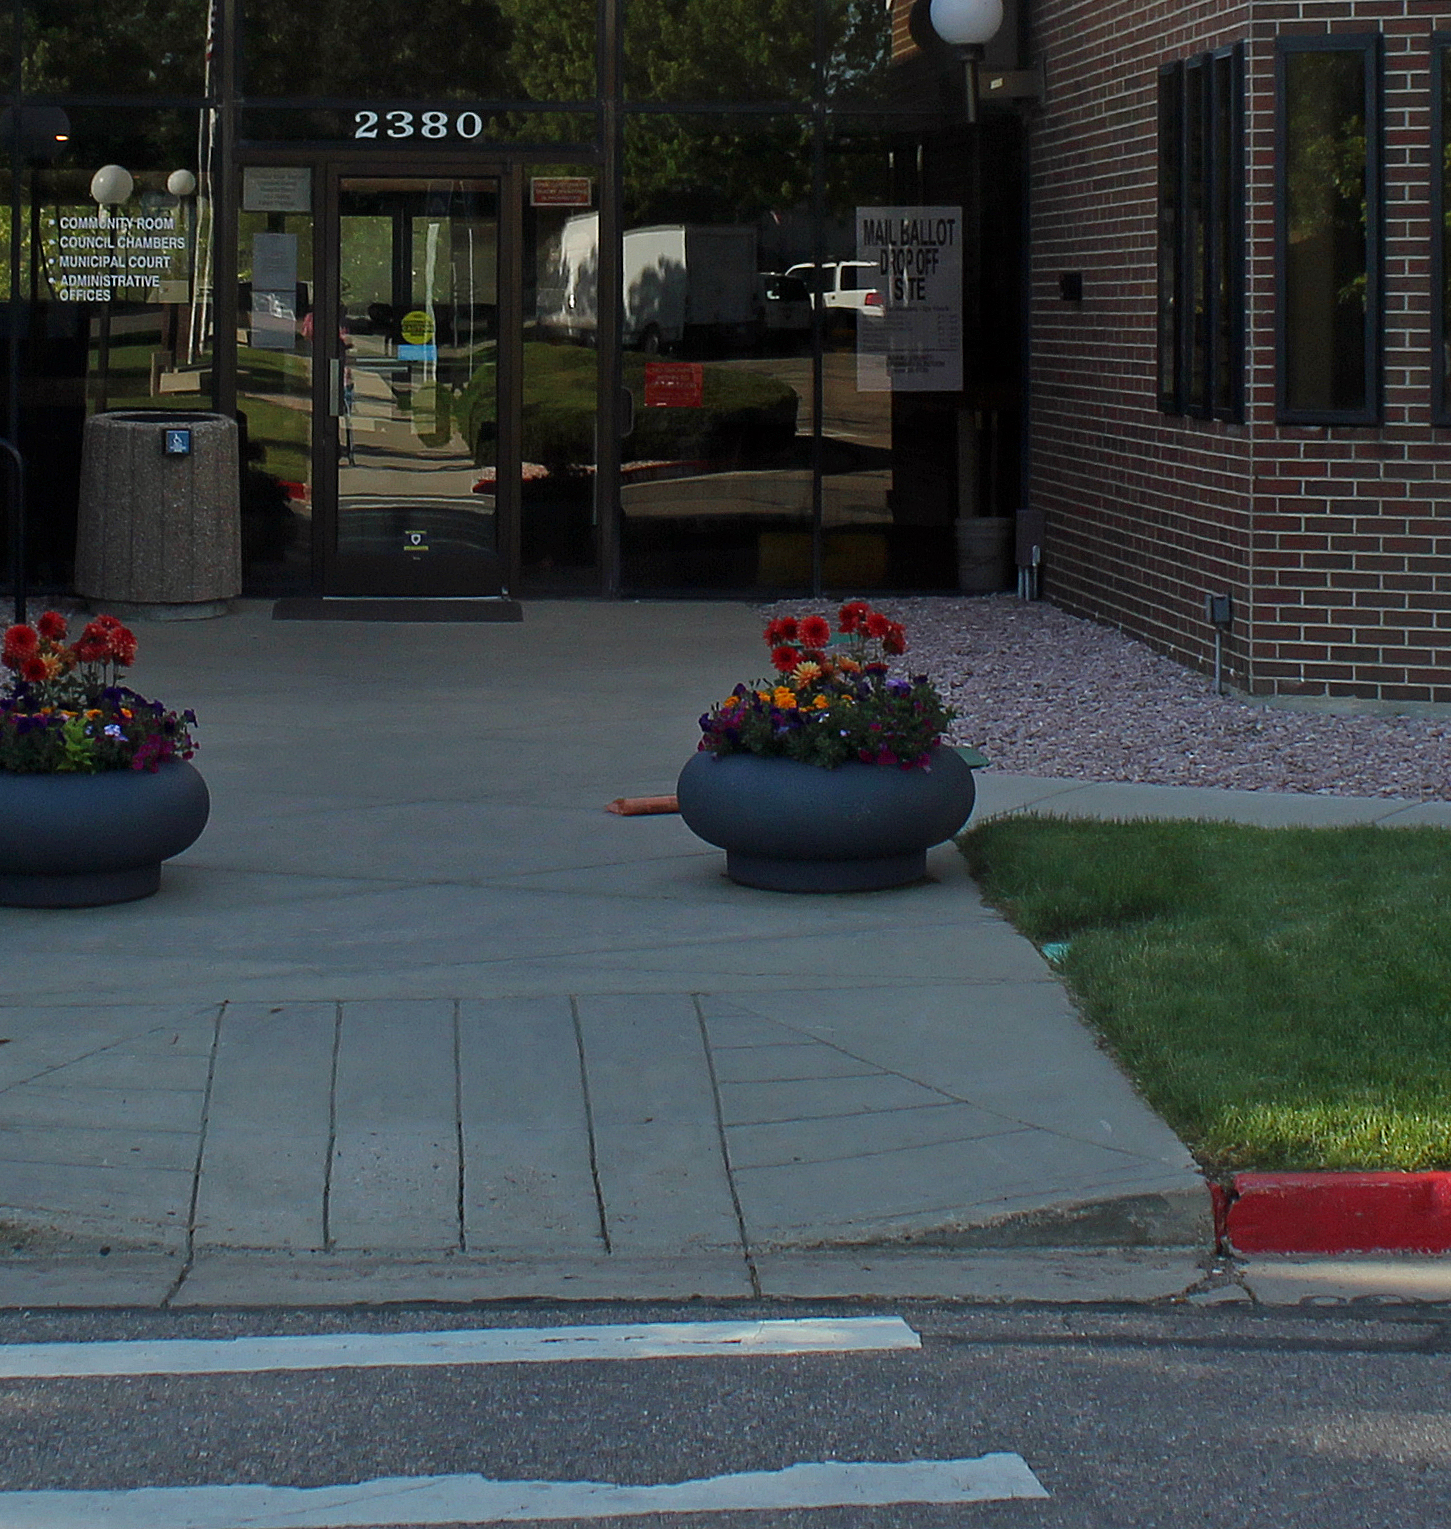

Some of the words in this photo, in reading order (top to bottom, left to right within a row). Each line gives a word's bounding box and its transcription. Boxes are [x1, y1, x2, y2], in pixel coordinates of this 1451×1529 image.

[354, 110, 483, 139] 2380
[59, 217, 133, 230] COMMUNITY
[136, 217, 174, 230] ROOM
[862, 219, 897, 246] MAIL
[900, 219, 956, 246] BALLOT
[59, 236, 115, 249] COUNCIL
[117, 237, 186, 249] CHAMBERS
[59, 255, 126, 268] MUNICIPAL
[128, 256, 171, 269] COURT
[880, 248, 914, 276] DROP
[916, 248, 940, 275] OFF
[60, 274, 160, 288] ADMINISTRATIVE
[59, 289, 111, 302] OFFICES
[893, 277, 927, 301] STE
